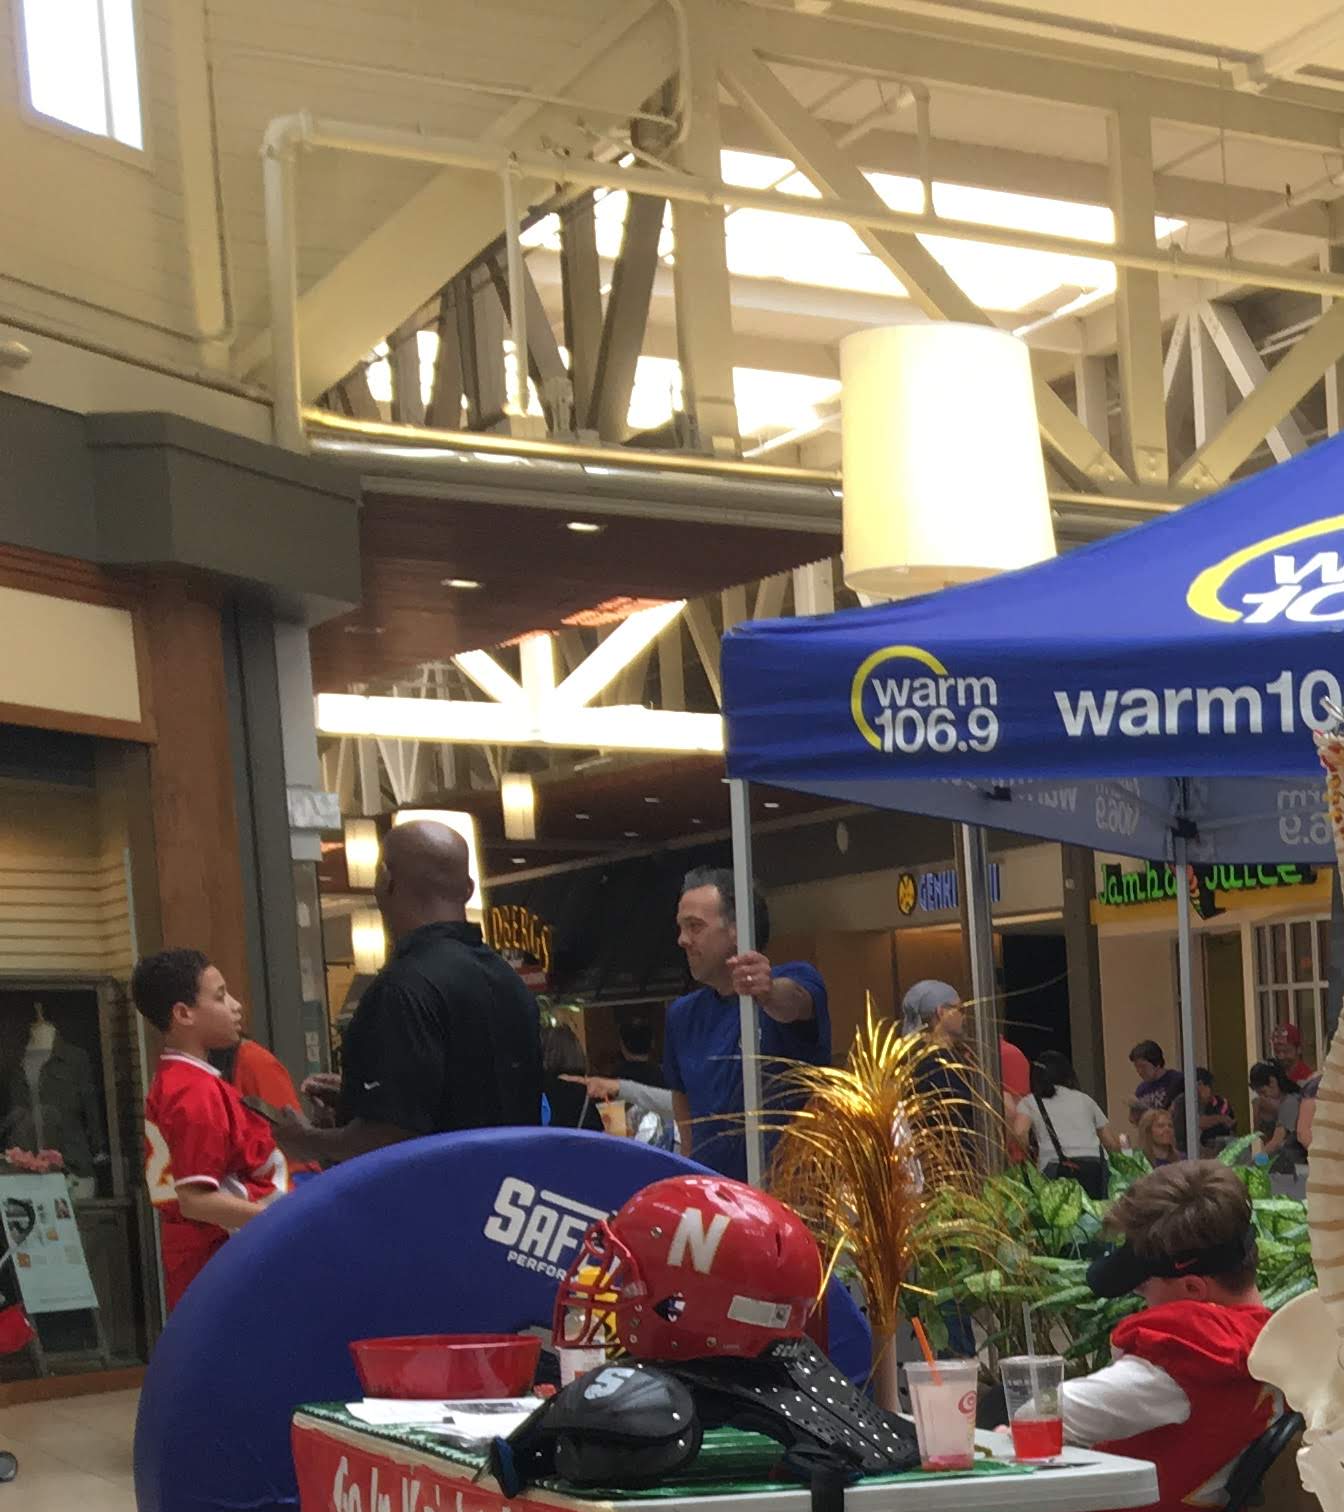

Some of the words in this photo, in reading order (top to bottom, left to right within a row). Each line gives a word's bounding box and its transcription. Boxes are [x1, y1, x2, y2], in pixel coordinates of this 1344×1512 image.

[873, 673, 998, 708] warm
[875, 705, 999, 754] 106.9
[484, 1177, 588, 1263] SAF
[667, 1207, 731, 1275] N
[507, 1251, 569, 1282] PERFOR
[585, 1367, 636, 1400] S
